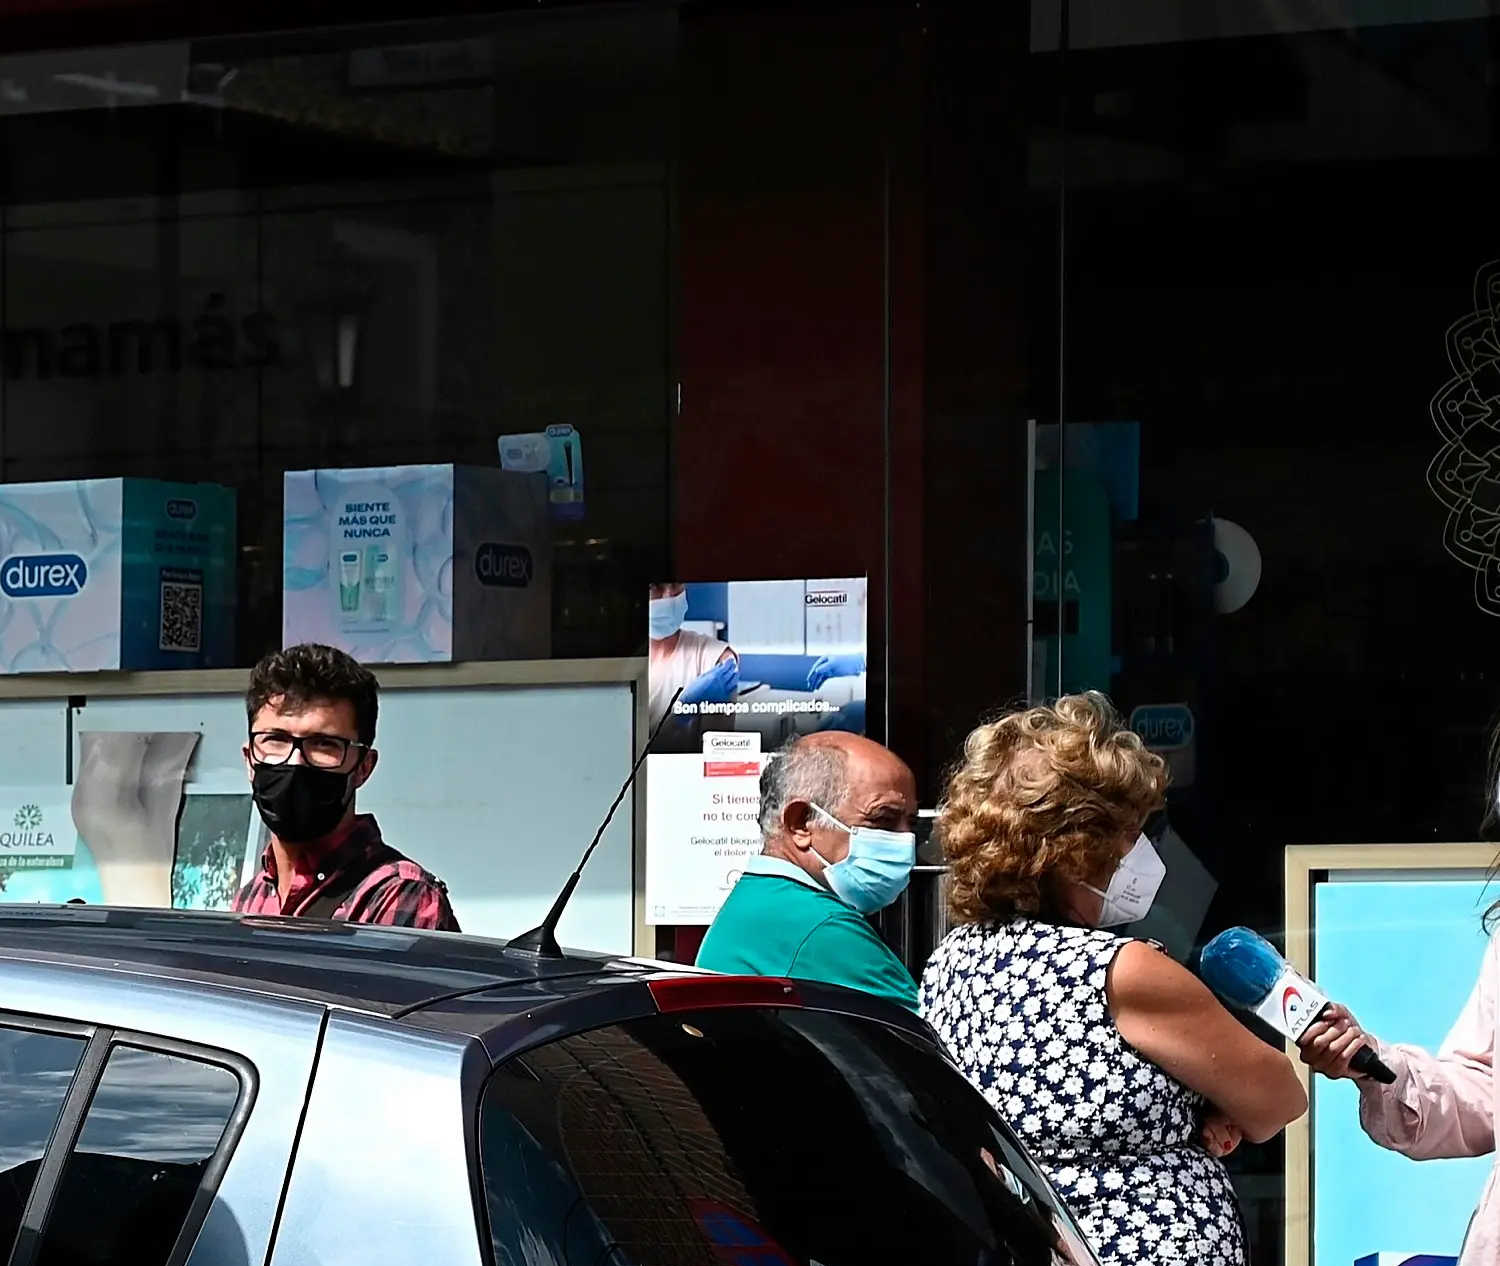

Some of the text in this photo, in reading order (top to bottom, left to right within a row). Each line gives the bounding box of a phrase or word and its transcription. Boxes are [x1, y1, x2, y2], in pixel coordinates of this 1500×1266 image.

[345, 502, 390, 513] SIENTE
[339, 514, 397, 526] MÁS QUE
[344, 528, 391, 538] NUNCA
[480, 550, 530, 579] durex
[6, 560, 83, 589] durex
[805, 593, 848, 605] Gelocatil
[673, 701, 697, 714] Son
[700, 700, 749, 716] tiempos
[1137, 713, 1188, 737] durex
[711, 737, 751, 748] Gelocatil
[712, 793, 724, 804] Si
[703, 813, 718, 821] no
[721, 811, 733, 821] te
[1291, 1000, 1319, 1035] ATLAS
